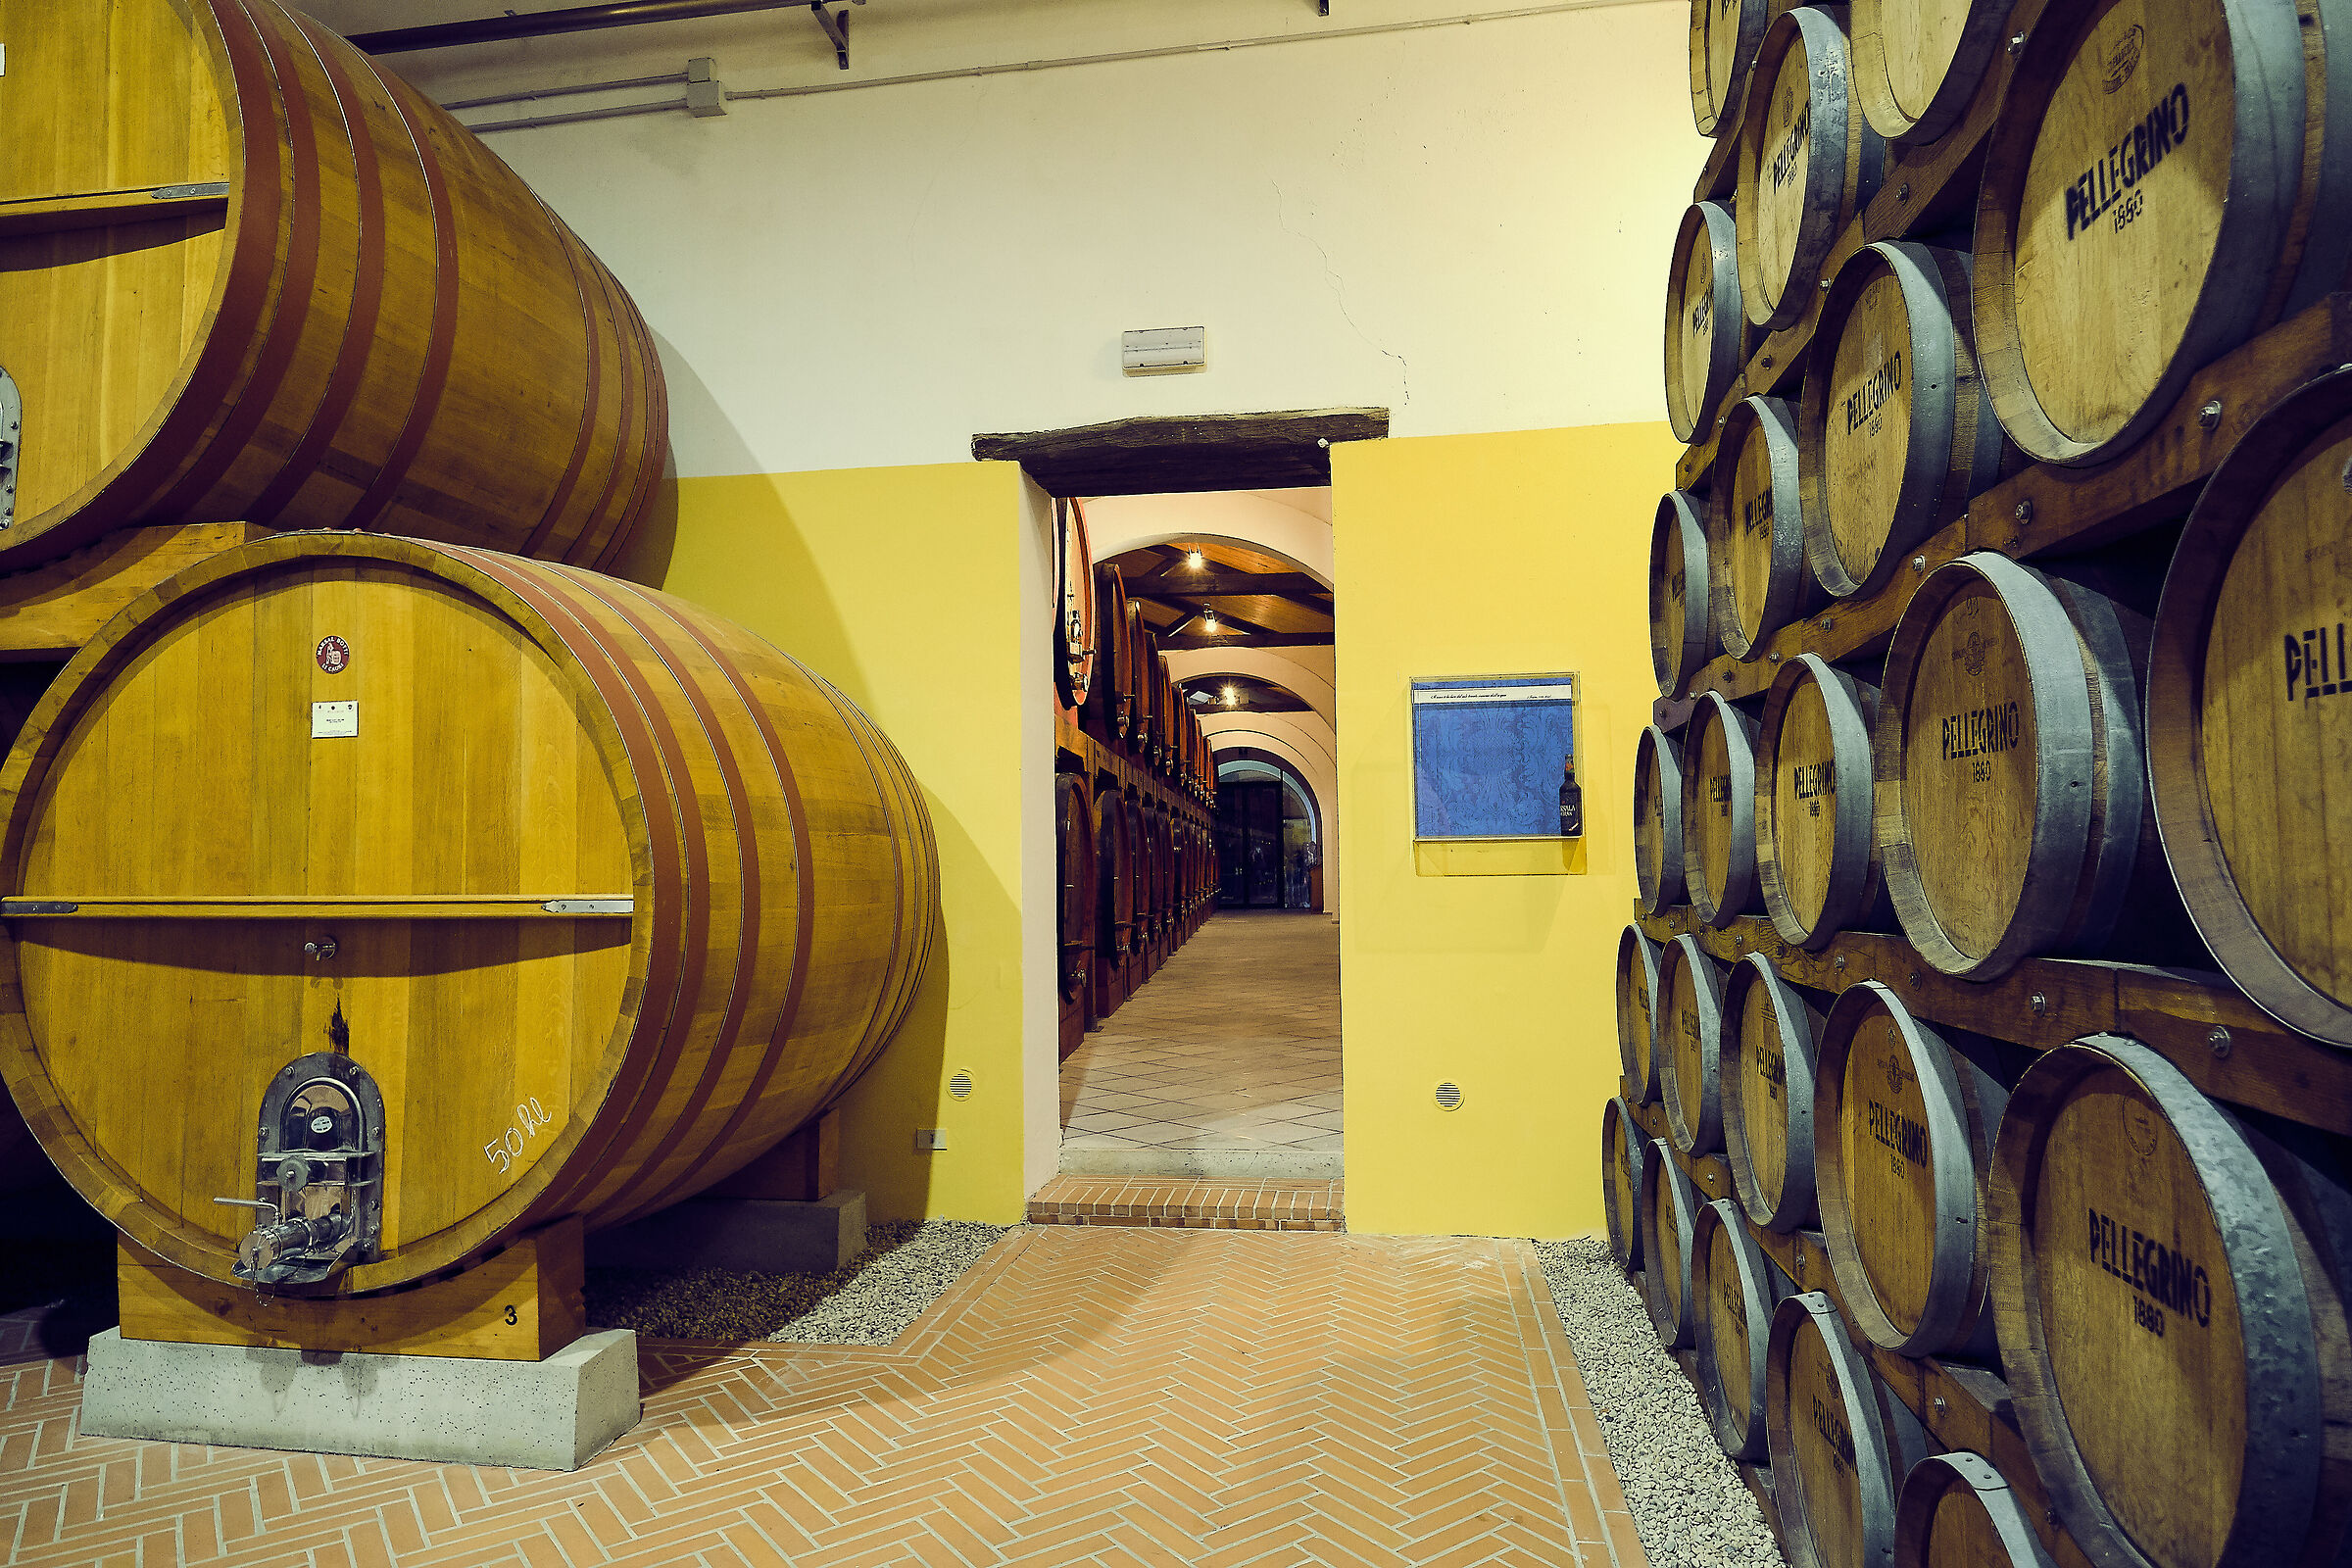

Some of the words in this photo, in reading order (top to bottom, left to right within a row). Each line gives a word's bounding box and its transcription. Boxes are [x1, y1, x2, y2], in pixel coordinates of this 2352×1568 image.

[1773, 99, 1811, 195] PELLEGRINO
[2065, 82, 2189, 241] PELLEGRINO
[2112, 188, 2143, 234] 1880
[1846, 350, 1902, 435] PELLEGRINO
[1942, 701, 2019, 760] PELLEGRINO
[1794, 759, 1836, 800] PELLEGRINO
[1972, 760, 1991, 782] 1880
[1868, 1099, 1928, 1168] PELLEGRINO
[2088, 1206, 2211, 1328] PELLEGRINO
[504, 1304, 518, 1326] 3
[2132, 1294, 2164, 1339] 1880
